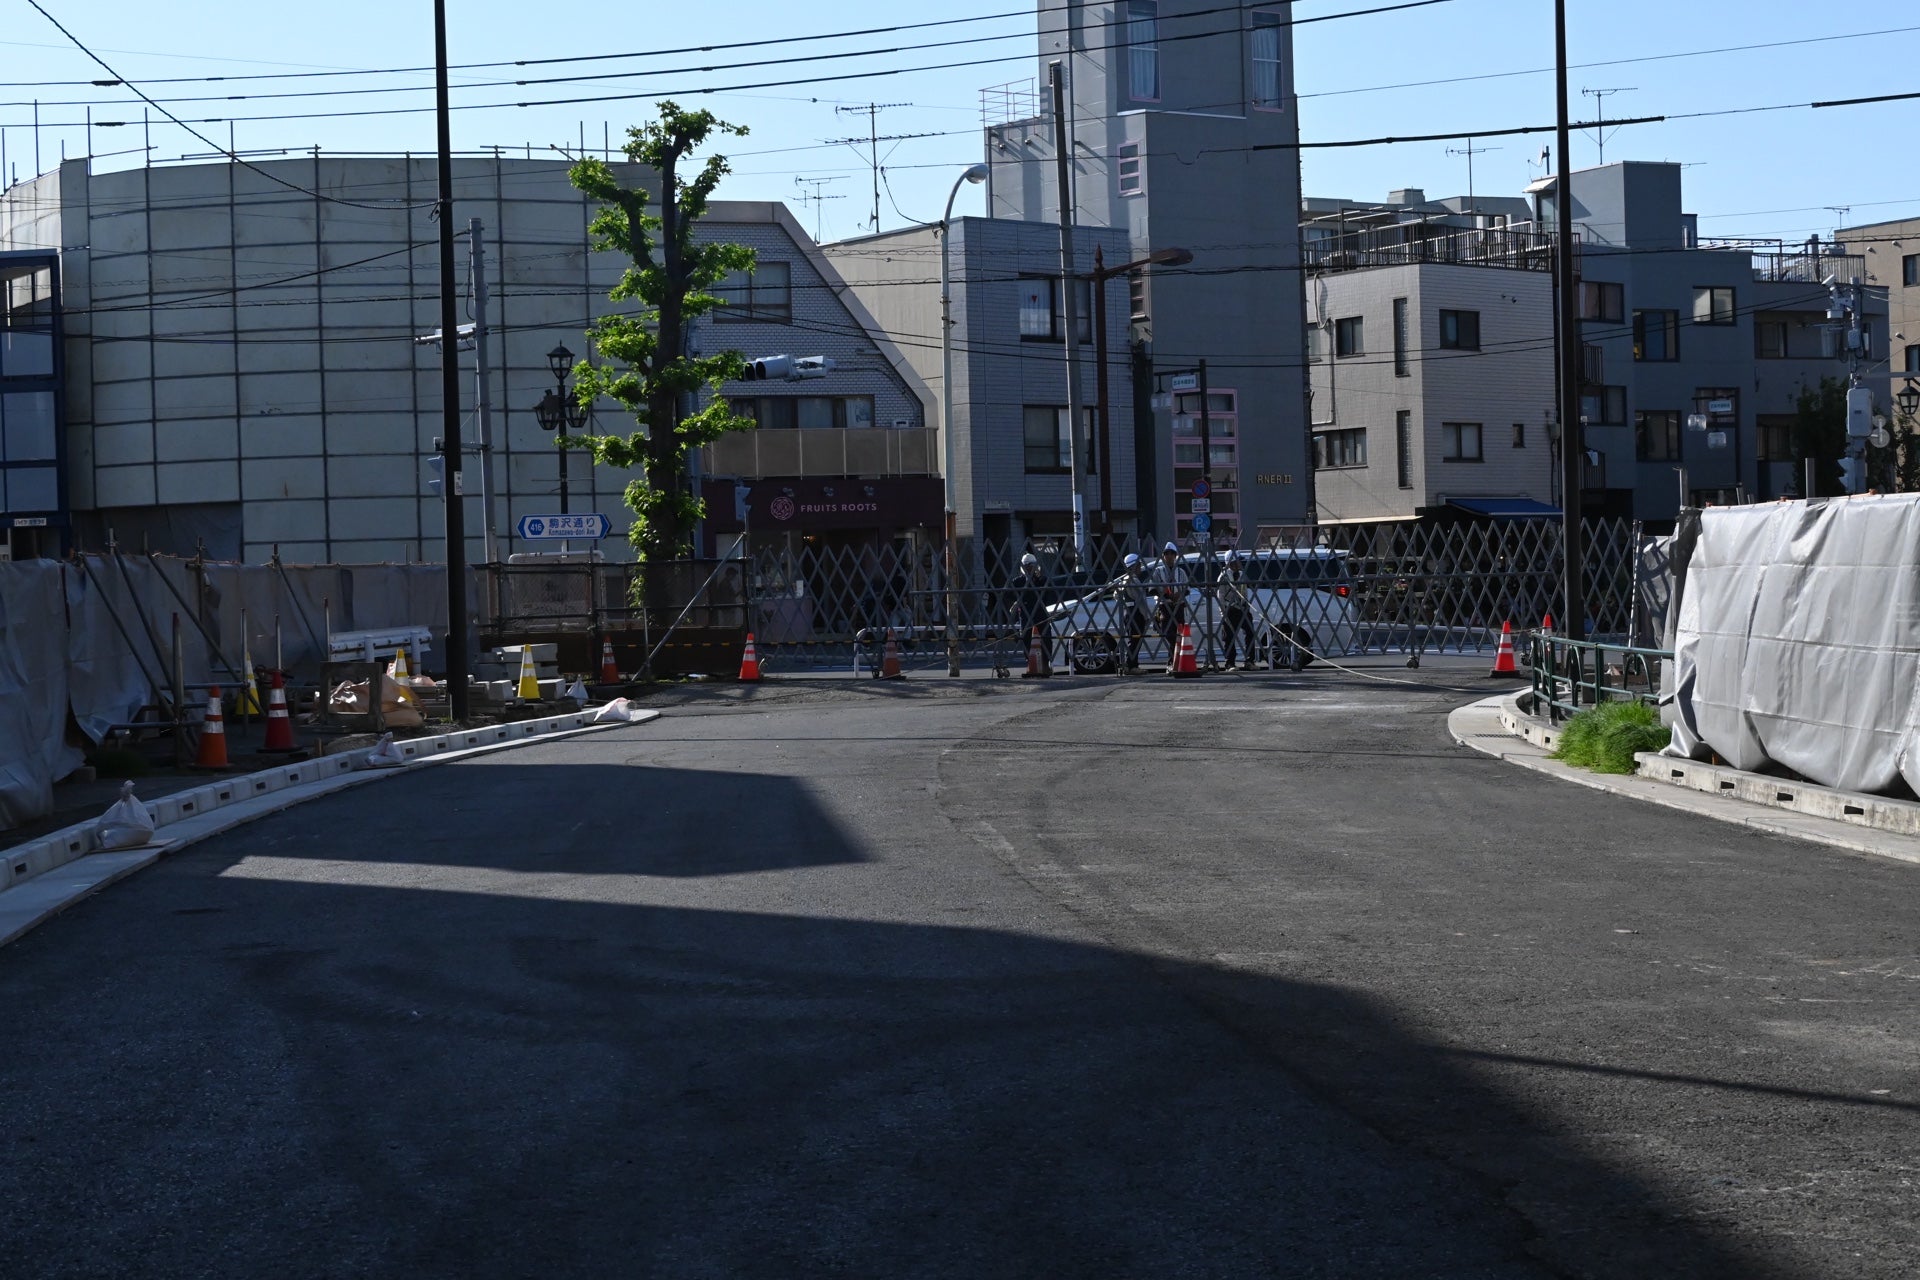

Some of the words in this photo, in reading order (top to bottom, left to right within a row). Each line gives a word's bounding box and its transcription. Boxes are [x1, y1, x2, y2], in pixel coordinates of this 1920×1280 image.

[800, 504, 838, 513] FRUITS
[841, 503, 878, 512] ROOTS
[530, 523, 542, 532] 416
[549, 517, 595, 528] 駒沢通り
